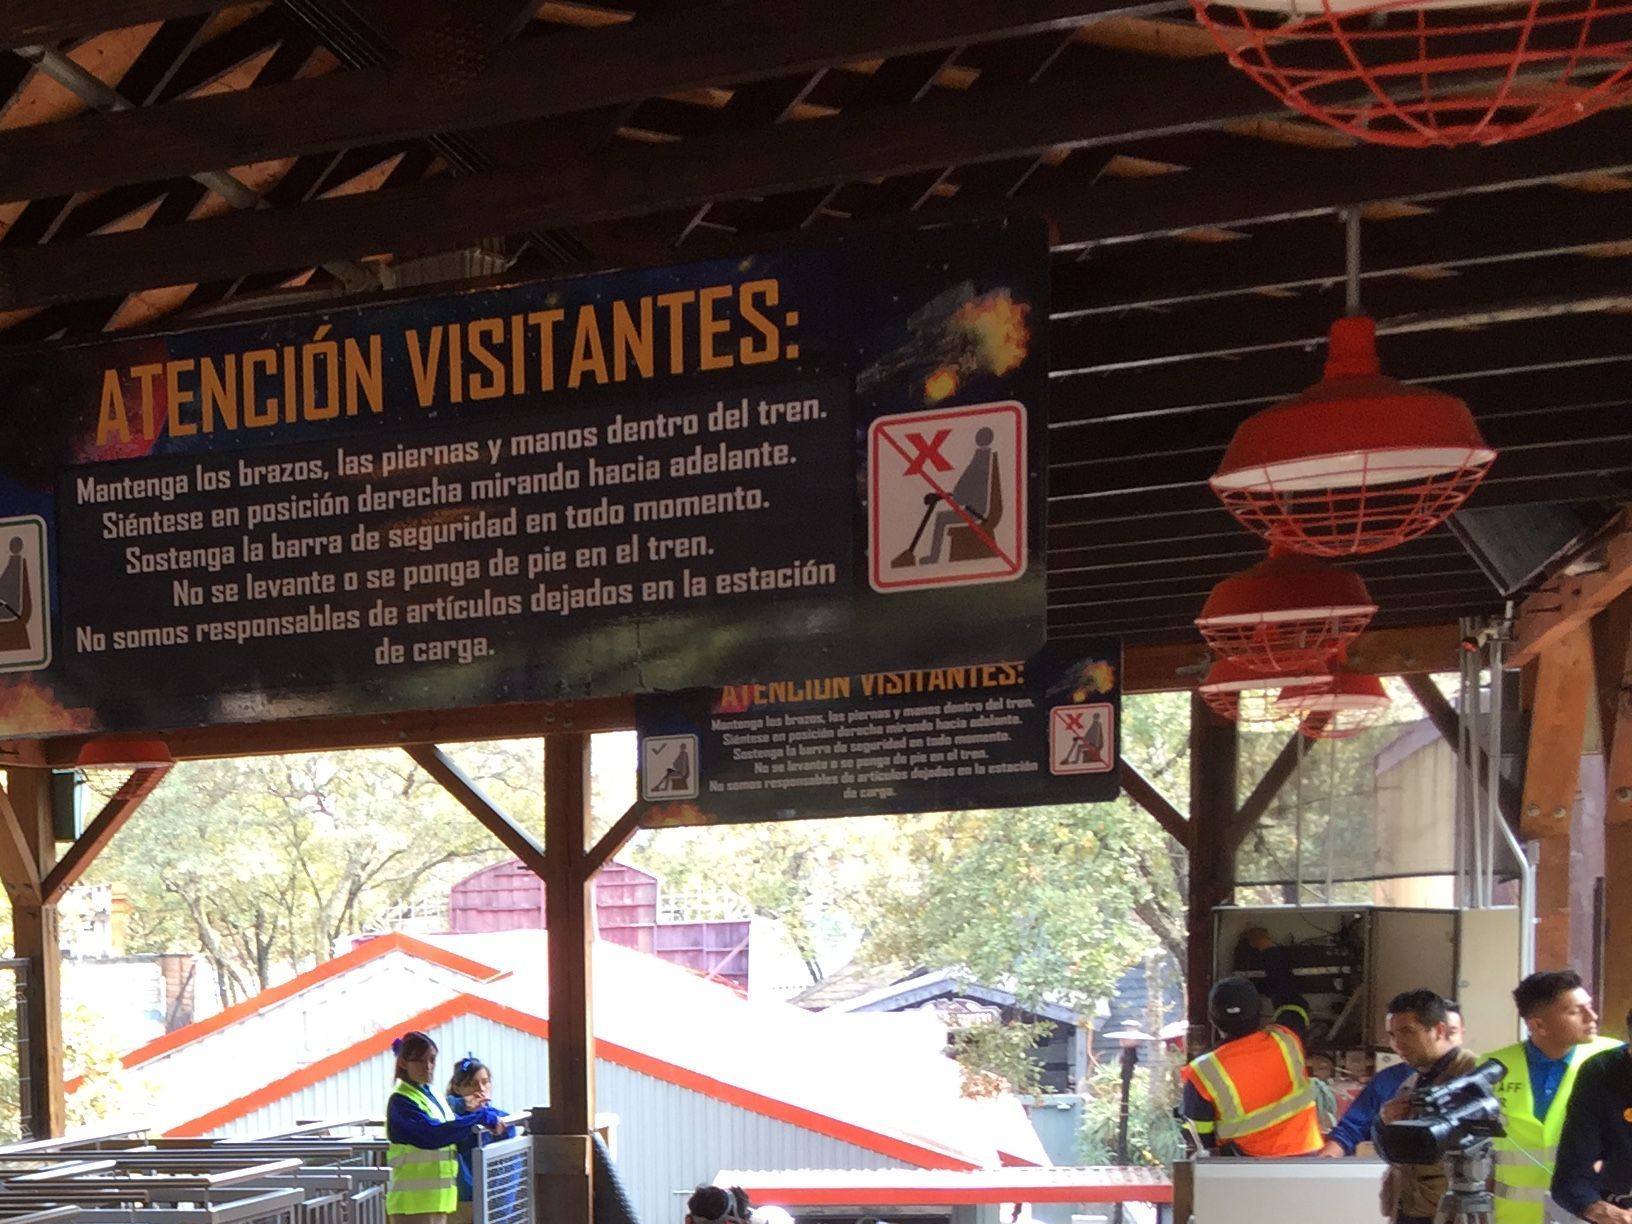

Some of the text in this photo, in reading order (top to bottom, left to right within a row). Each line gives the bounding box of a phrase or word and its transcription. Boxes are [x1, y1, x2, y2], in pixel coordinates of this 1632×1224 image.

[95, 278, 800, 447] ATENCIÓN VISITANTES:
[76, 398, 828, 505] Mantenga los brazos, las piernas y manos dentro del tren.
[102, 441, 797, 540] Siéntese en posición derecha mirando hacia adelante.
[125, 486, 771, 575] Sostenga la barra de seguridad en todo momento.
[172, 533, 715, 607] No se levante o se ponga de pie en el tren.
[76, 557, 837, 653] No somos responsables de artículos dejados en la estación
[374, 635, 496, 666] de carga.
